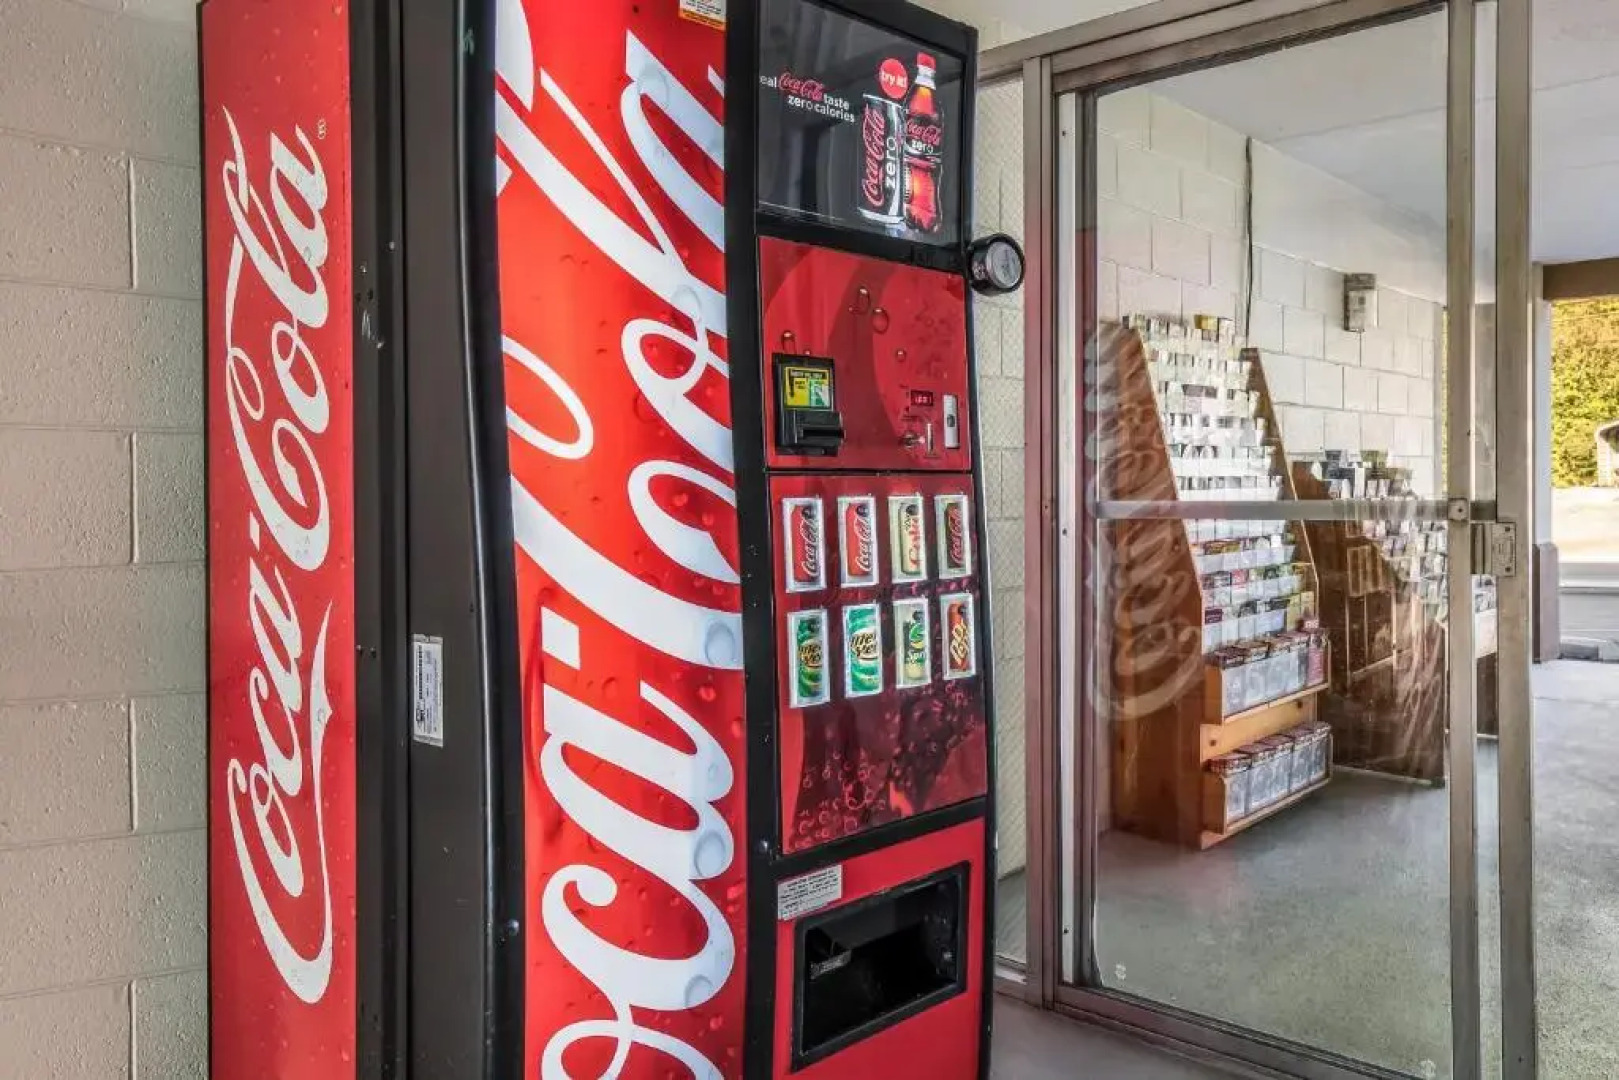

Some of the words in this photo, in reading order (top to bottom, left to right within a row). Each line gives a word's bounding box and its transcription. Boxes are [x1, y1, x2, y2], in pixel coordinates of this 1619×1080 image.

[778, 72, 824, 101] Coca-Cola
[823, 93, 850, 110] taste
[788, 94, 813, 109] zero
[814, 103, 855, 123] calories
[862, 104, 885, 206] Coca-Cola
[885, 136, 897, 189] zero
[221, 105, 333, 1004] Coca-Cola
